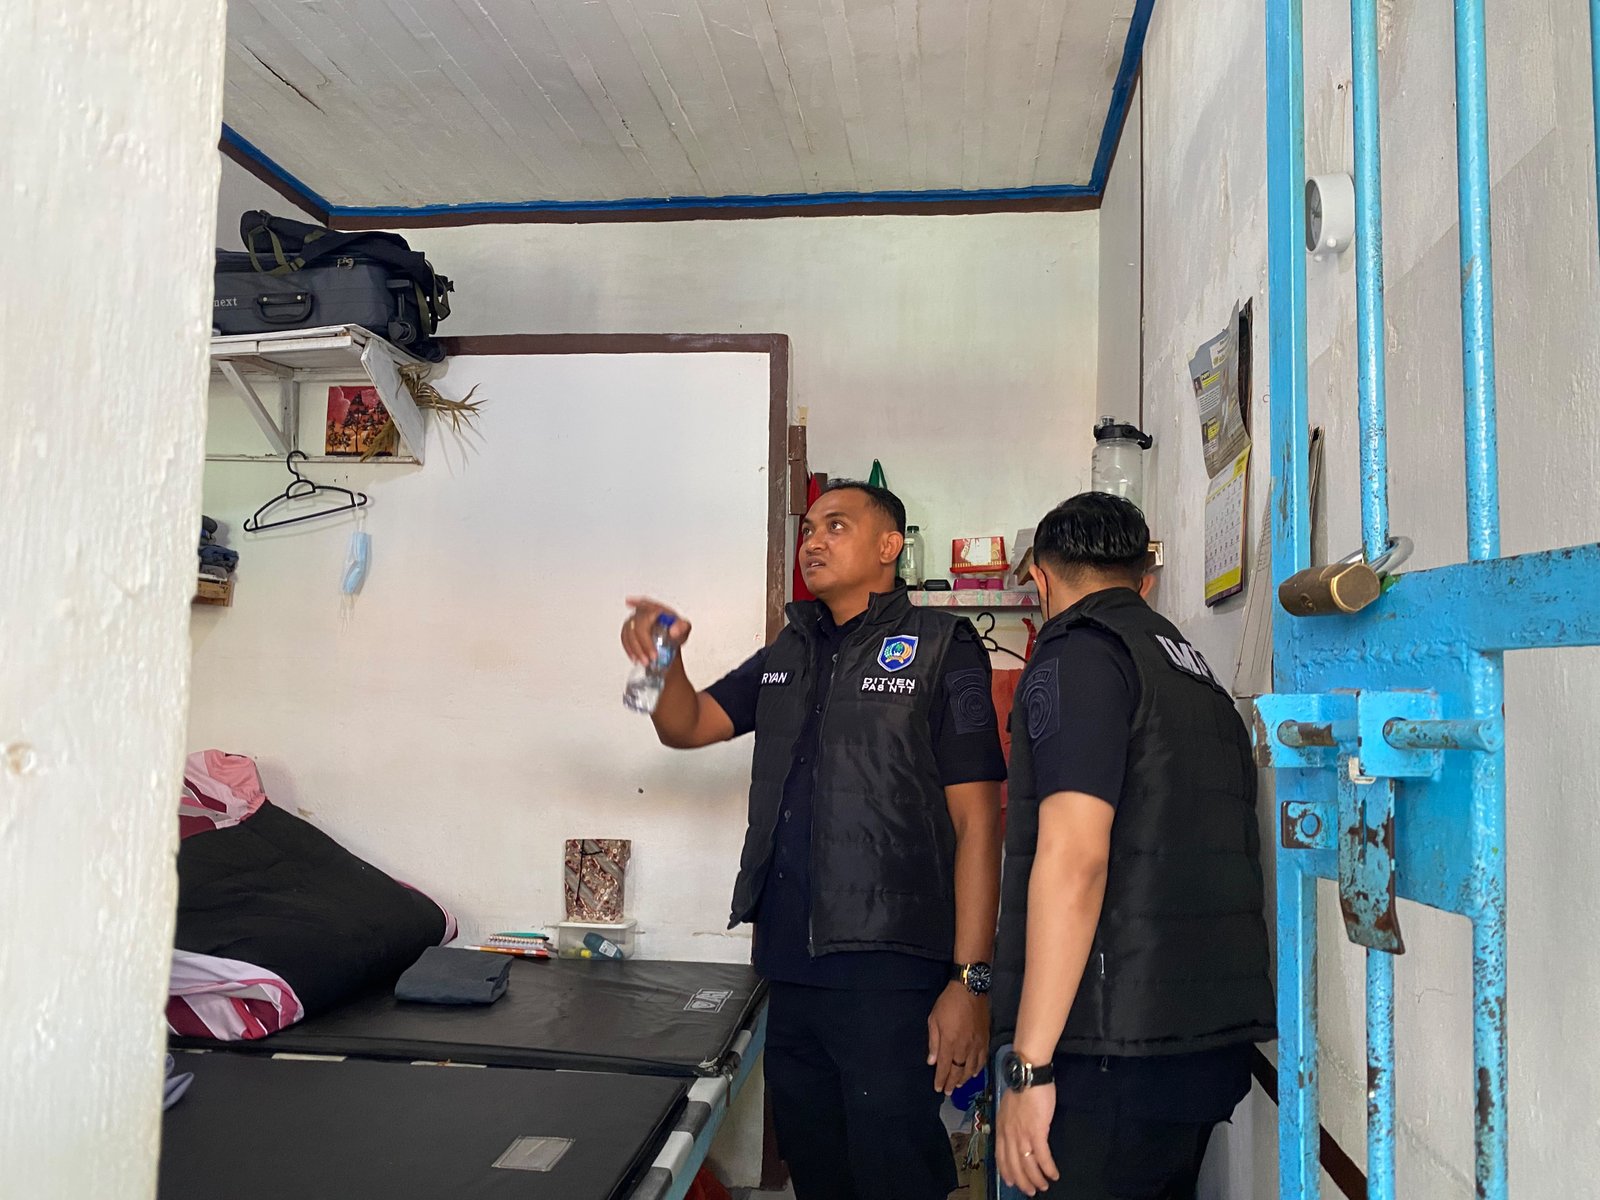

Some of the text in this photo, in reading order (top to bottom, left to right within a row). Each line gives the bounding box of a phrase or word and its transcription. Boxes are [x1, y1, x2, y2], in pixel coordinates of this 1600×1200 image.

[761, 672, 788, 684] RYAN
[863, 677, 915, 686] DITJEN
[888, 685, 916, 694] NTT
